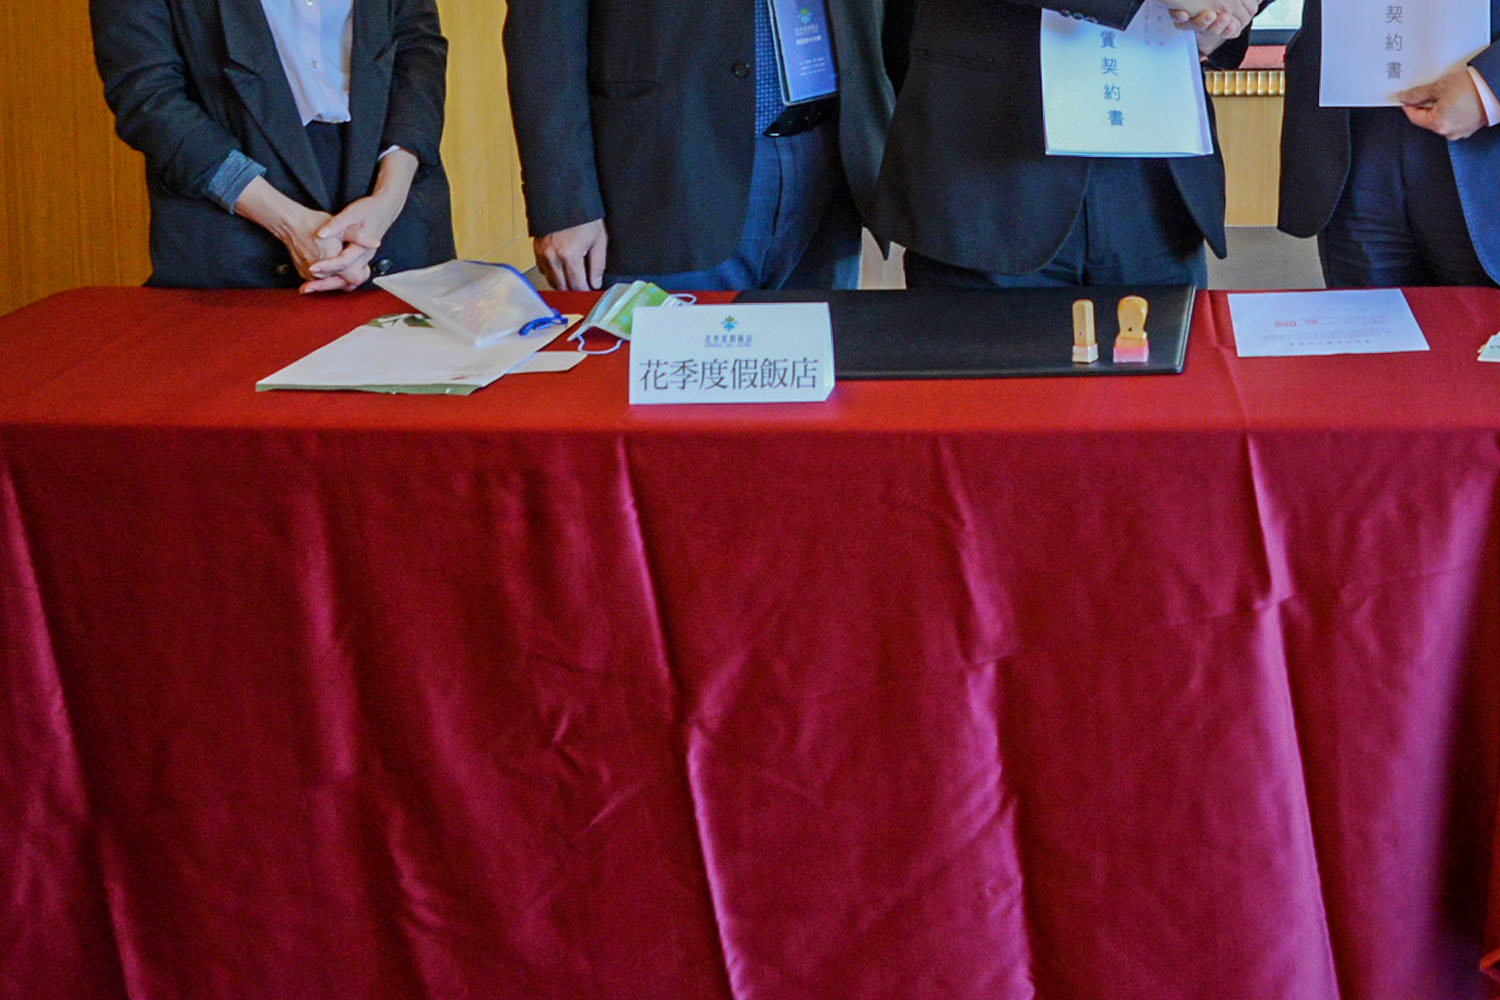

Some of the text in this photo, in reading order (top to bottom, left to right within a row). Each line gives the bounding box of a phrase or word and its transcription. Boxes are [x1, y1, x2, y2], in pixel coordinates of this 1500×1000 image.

[639, 357, 819, 391] 花季度假飯店
